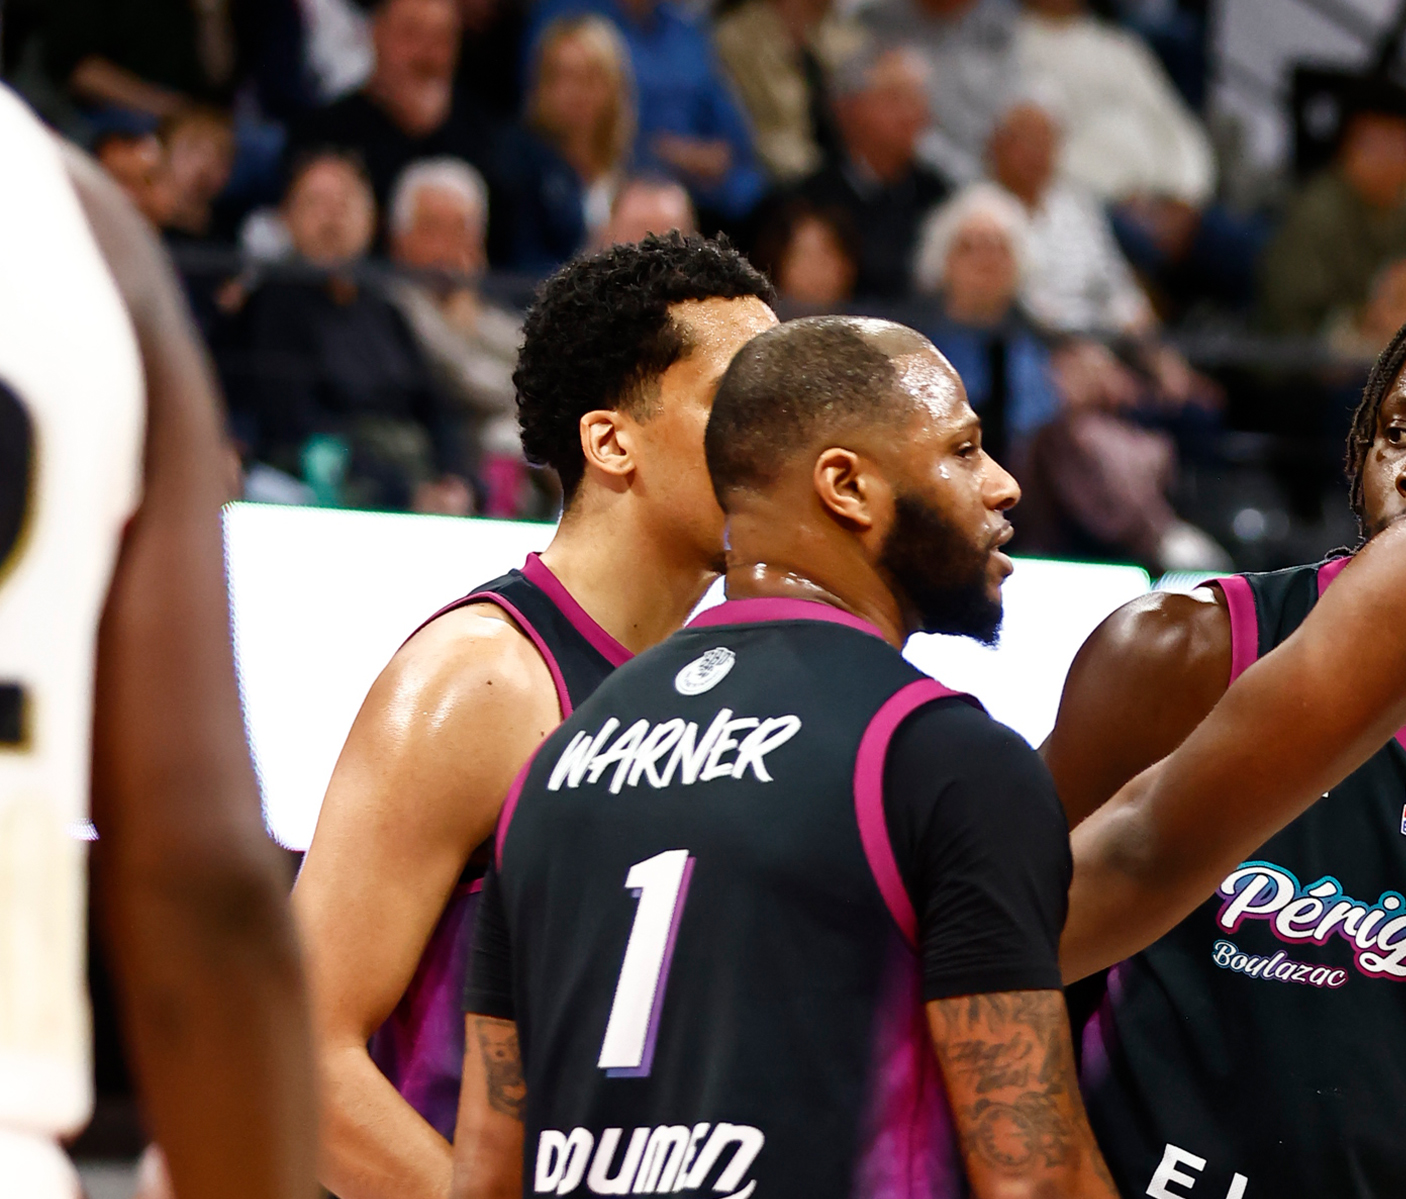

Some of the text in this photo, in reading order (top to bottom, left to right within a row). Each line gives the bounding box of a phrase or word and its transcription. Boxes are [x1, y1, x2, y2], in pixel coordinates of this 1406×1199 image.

[547, 708, 801, 794] WARNER
[597, 848, 697, 1078] 1
[1212, 940, 1347, 988] Boulazac
